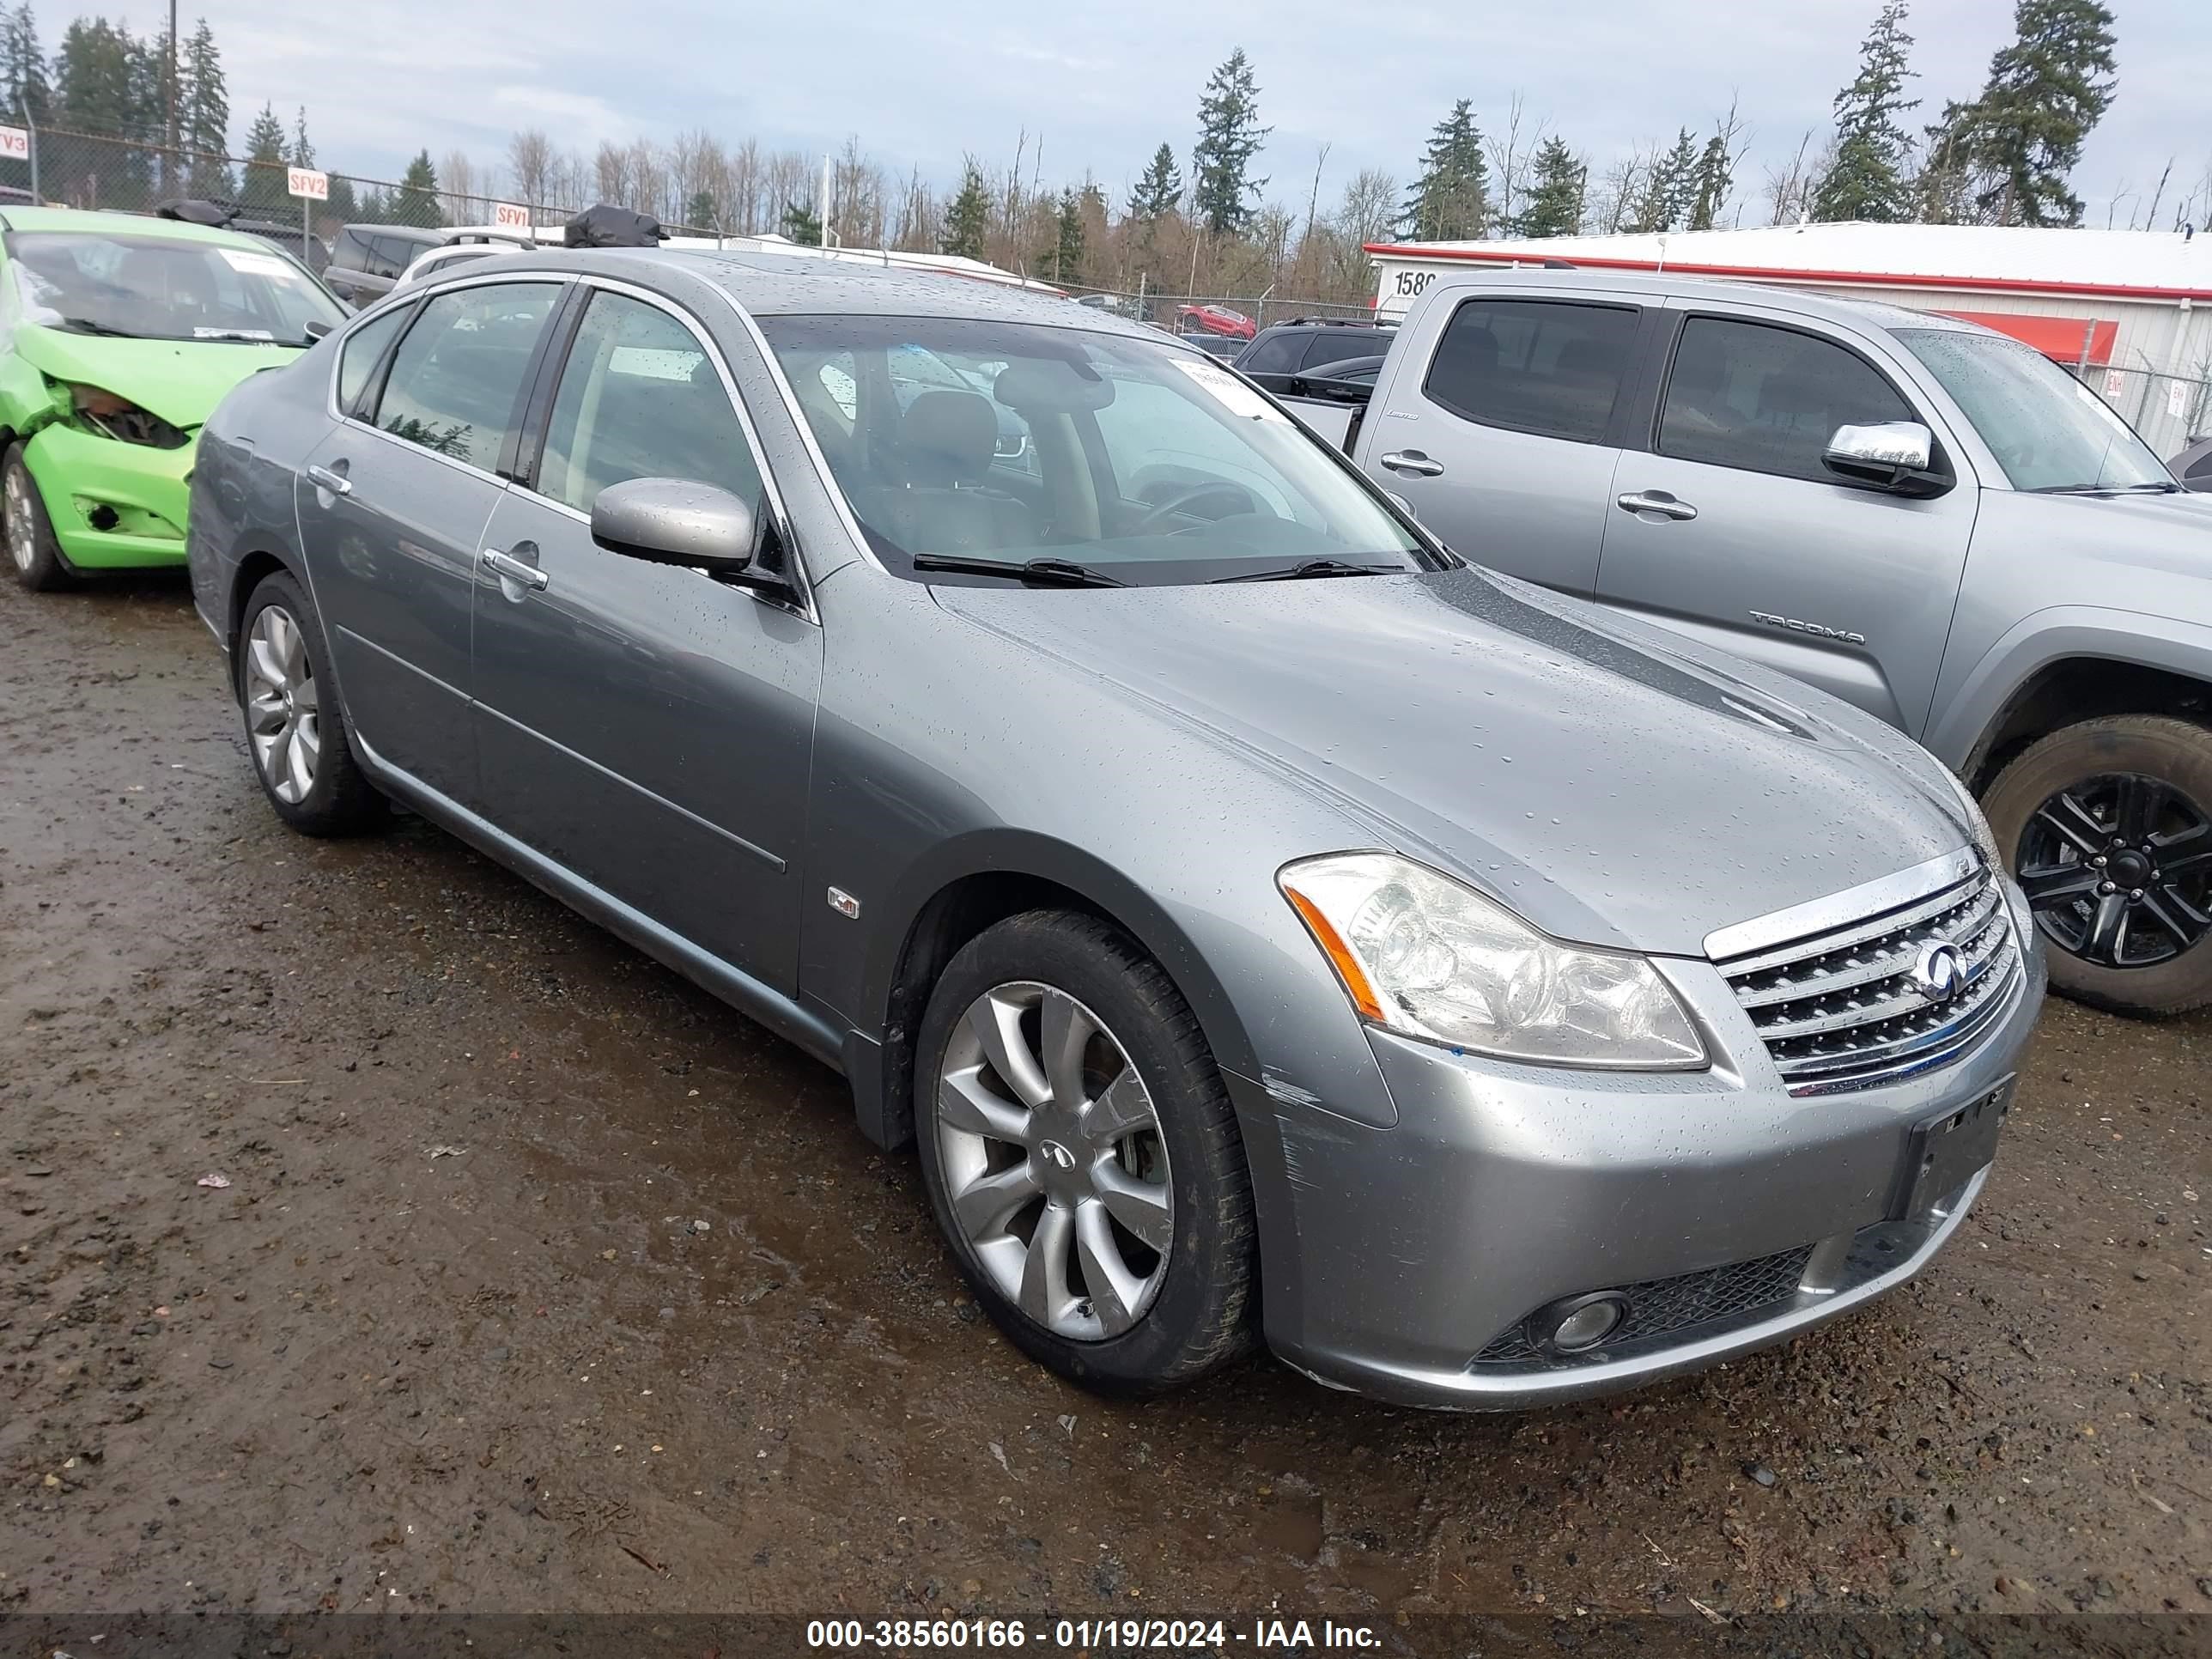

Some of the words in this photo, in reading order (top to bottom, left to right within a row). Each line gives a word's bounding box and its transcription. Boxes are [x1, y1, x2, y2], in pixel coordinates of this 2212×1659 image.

[290, 174, 325, 194] SFV2
[498, 207, 526, 227] SFV1
[1747, 610, 1866, 646] TACOMA
